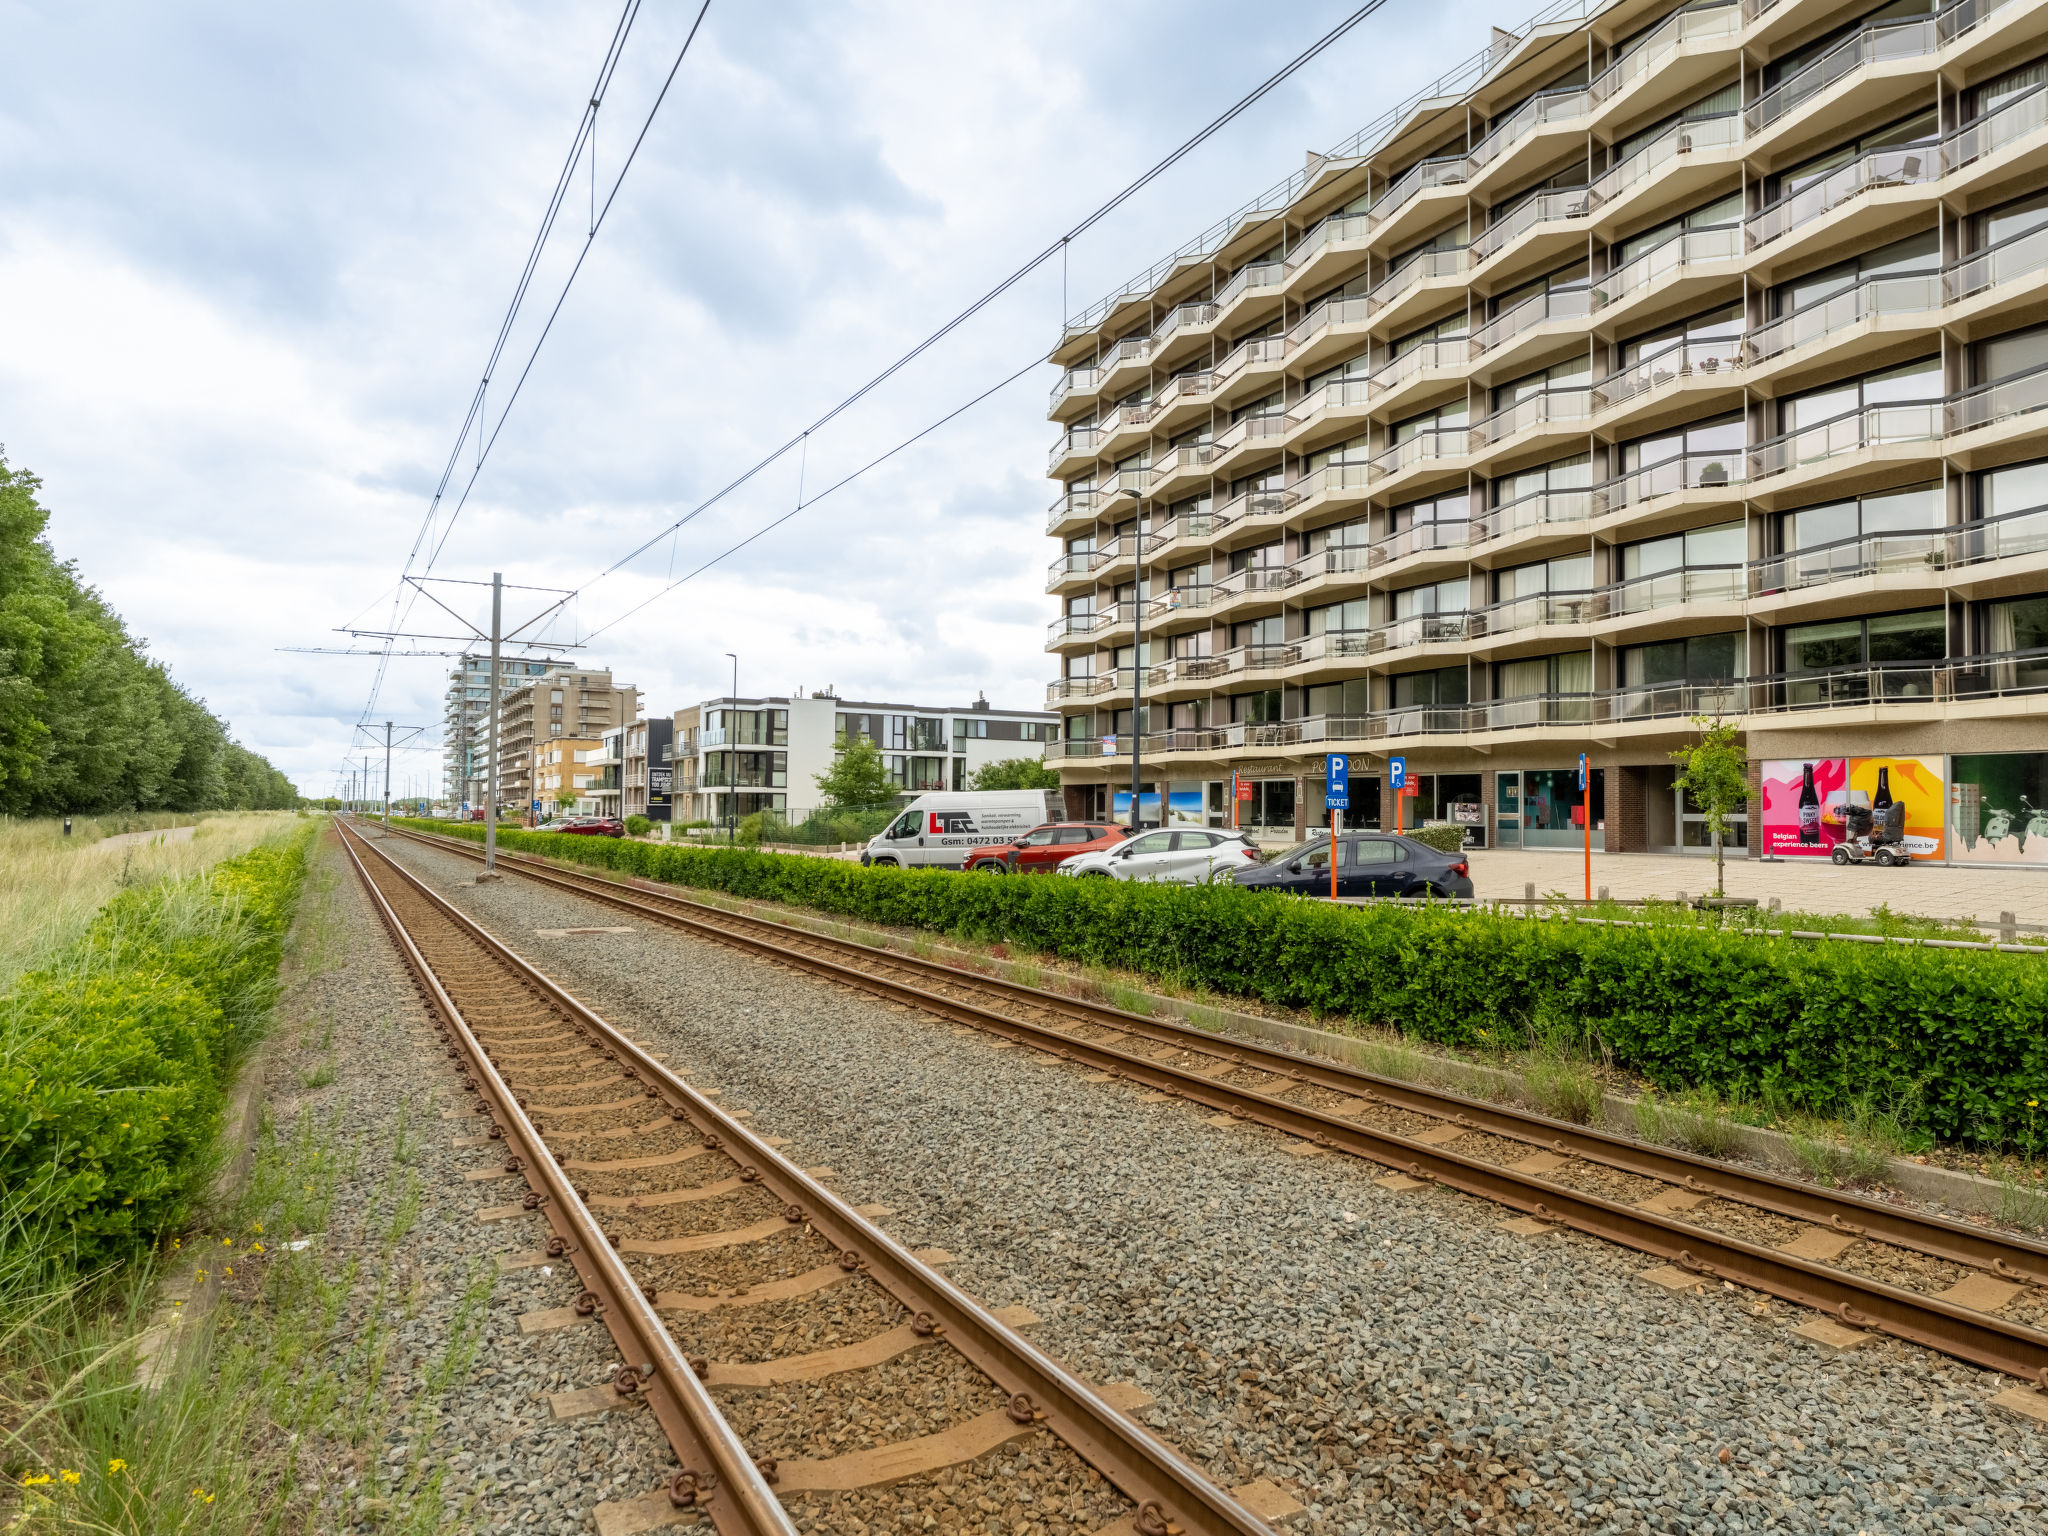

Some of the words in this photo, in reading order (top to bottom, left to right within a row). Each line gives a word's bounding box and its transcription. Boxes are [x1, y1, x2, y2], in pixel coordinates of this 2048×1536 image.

[1238, 762, 1283, 775] Restaurant
[1332, 757, 1343, 779] P
[1391, 762, 1402, 784] P
[1327, 798, 1348, 807] TICKET
[941, 837, 964, 845] Gsm:
[967, 836, 990, 845] 0472
[993, 836, 1004, 845] 03
[1772, 833, 1797, 841] Belgian
[1772, 841, 1808, 849] experience
